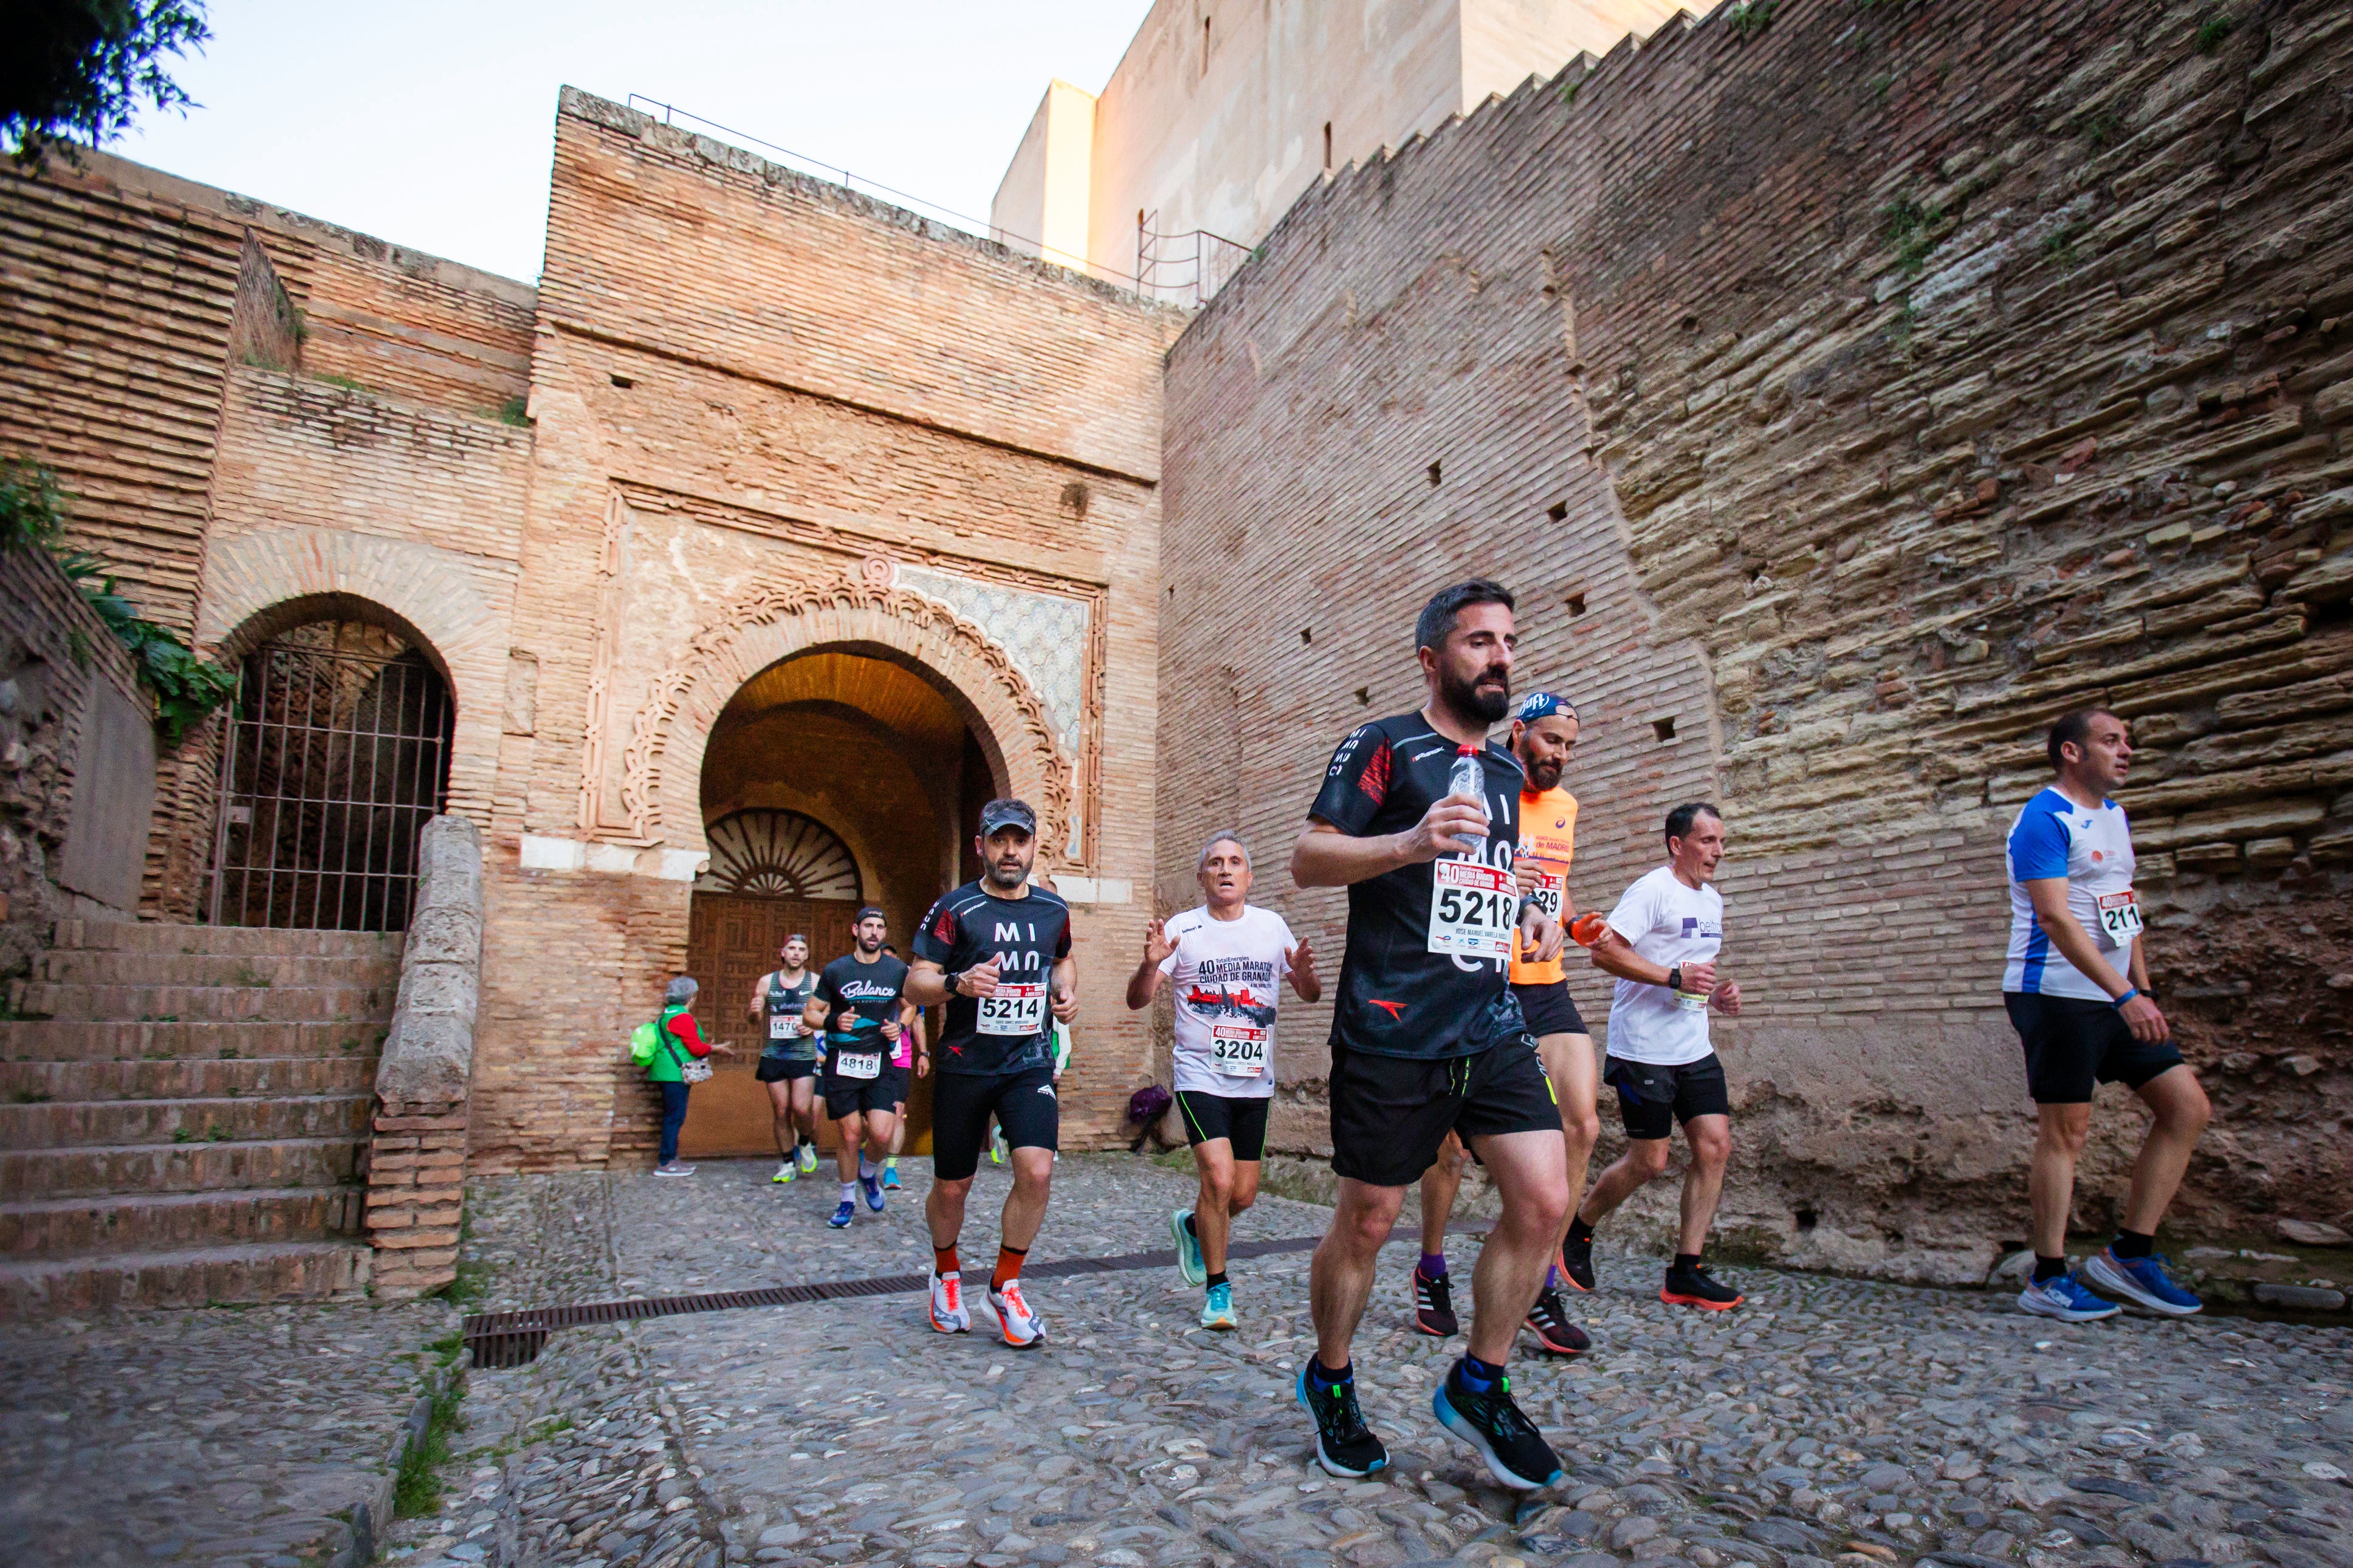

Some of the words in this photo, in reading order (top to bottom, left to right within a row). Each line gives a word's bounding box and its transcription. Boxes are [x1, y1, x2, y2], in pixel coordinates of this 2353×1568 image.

[1438, 889, 1512, 931] 5218
[2106, 905, 2139, 931] 211
[995, 922, 1036, 942] MI
[1199, 960, 1215, 975] 40
[1215, 956, 1249, 964] TotalEnergies
[1216, 962, 1241, 973] MEDIA
[1243, 961, 1273, 973] MARATÓN
[1200, 974, 1228, 983] CIUDAD
[1230, 972, 1240, 981] DE
[1242, 971, 1271, 982] GRANADA
[840, 979, 896, 999] Balance
[982, 998, 1038, 1019] 5214
[1215, 1027, 1226, 1037] 40
[1214, 1039, 1263, 1061] 3204
[841, 1057, 873, 1070] 4818
